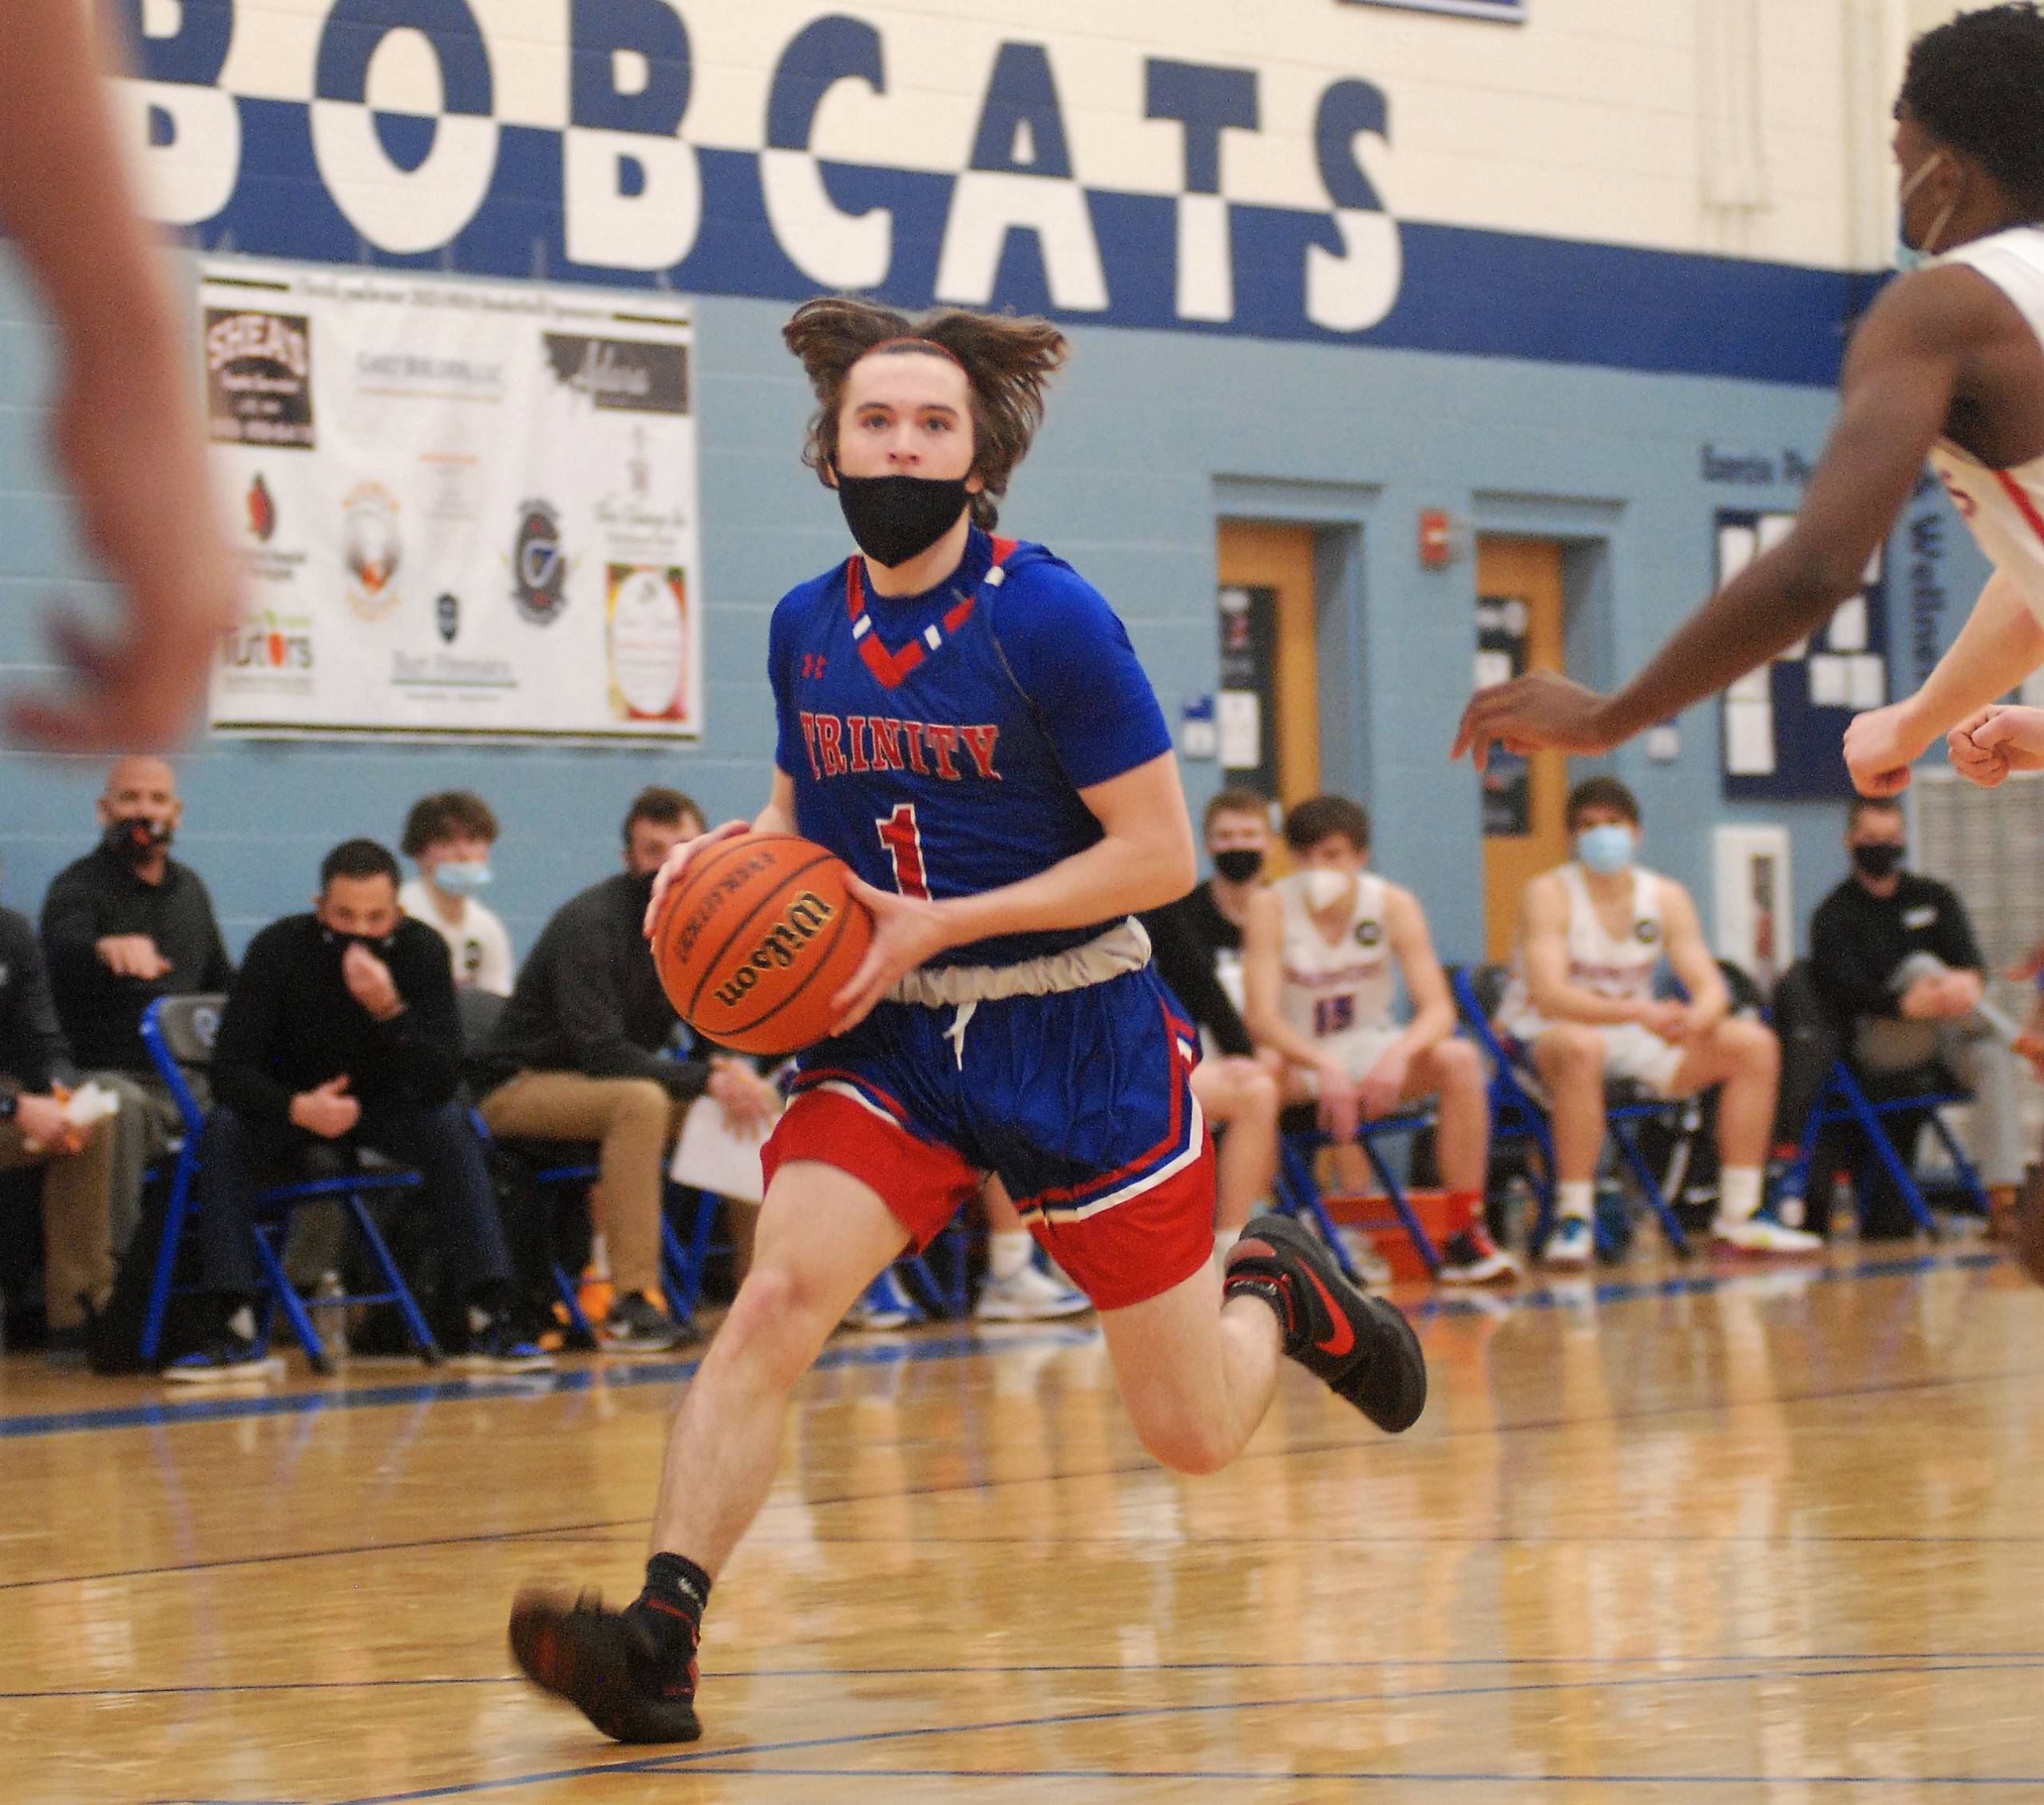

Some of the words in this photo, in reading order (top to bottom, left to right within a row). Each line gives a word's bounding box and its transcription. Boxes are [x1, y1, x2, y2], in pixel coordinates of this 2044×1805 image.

[102, 0, 1404, 332] BOBCATS
[799, 711, 1001, 782] TRINITY
[875, 803, 933, 902] 1
[712, 890, 834, 1007] Wilson
